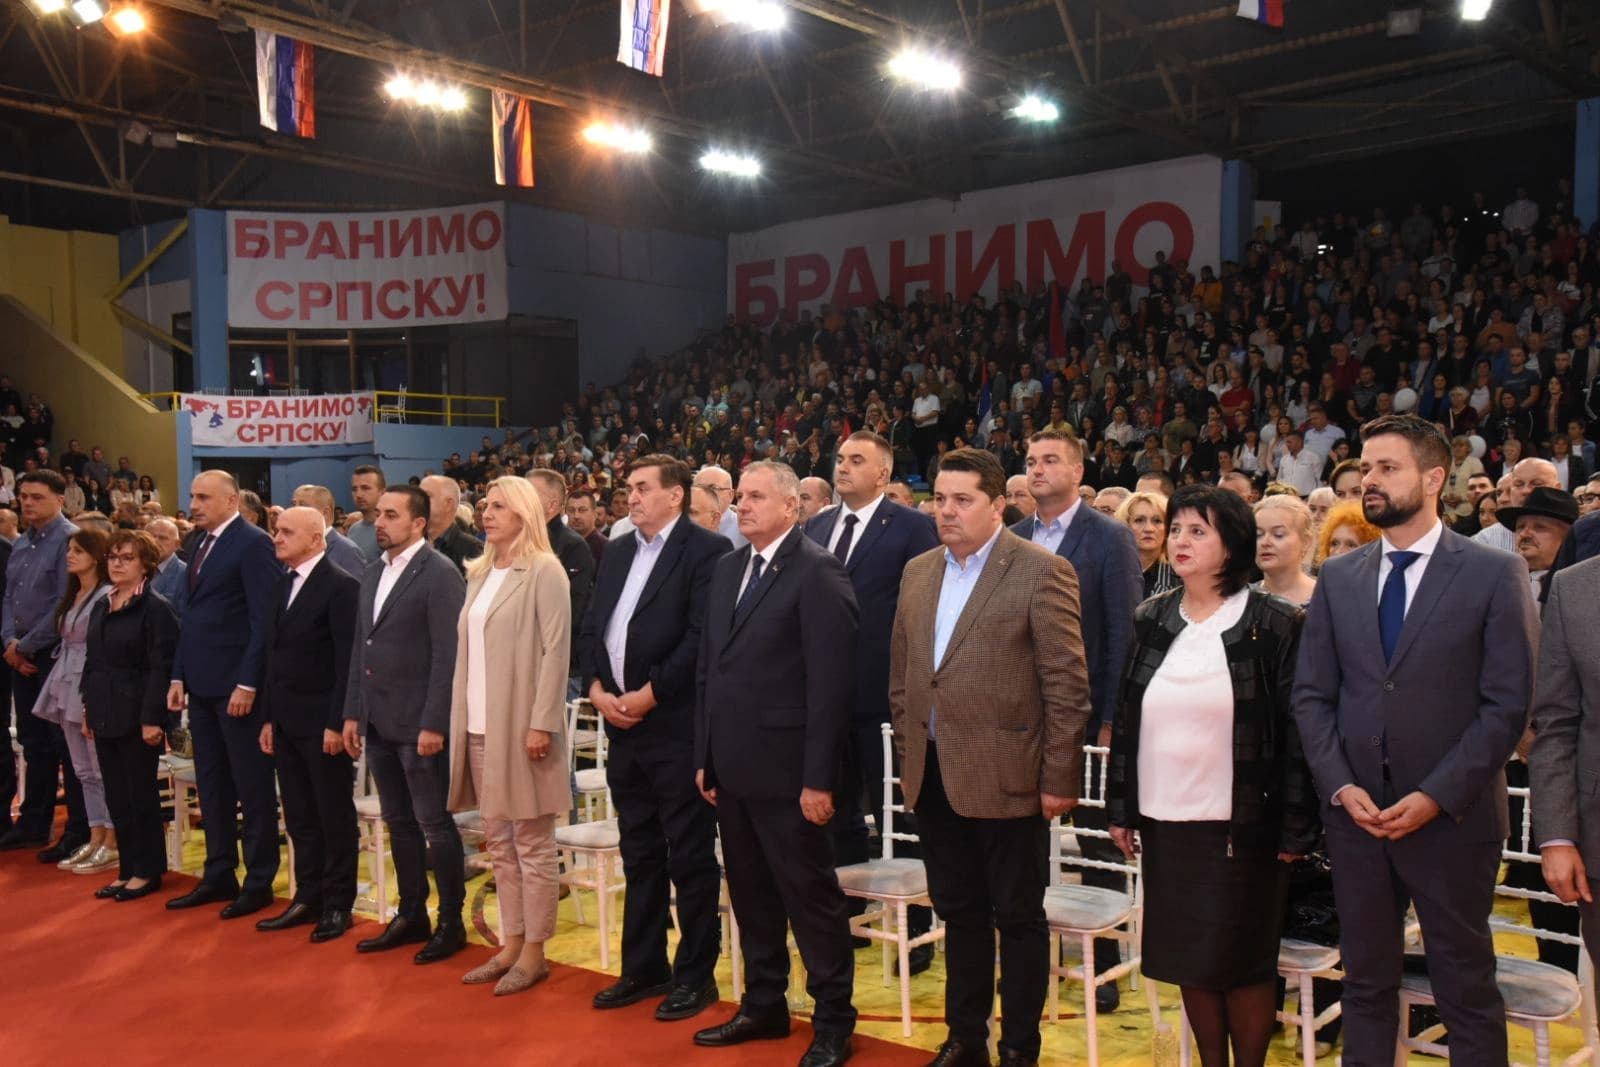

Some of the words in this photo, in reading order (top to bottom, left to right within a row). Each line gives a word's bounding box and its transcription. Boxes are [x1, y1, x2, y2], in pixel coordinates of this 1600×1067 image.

[234, 209, 502, 260] БРАНИМО
[735, 201, 1194, 328] БРАНИМО
[255, 272, 486, 321] СРПСКУ!
[227, 396, 355, 419] БРАНИМО
